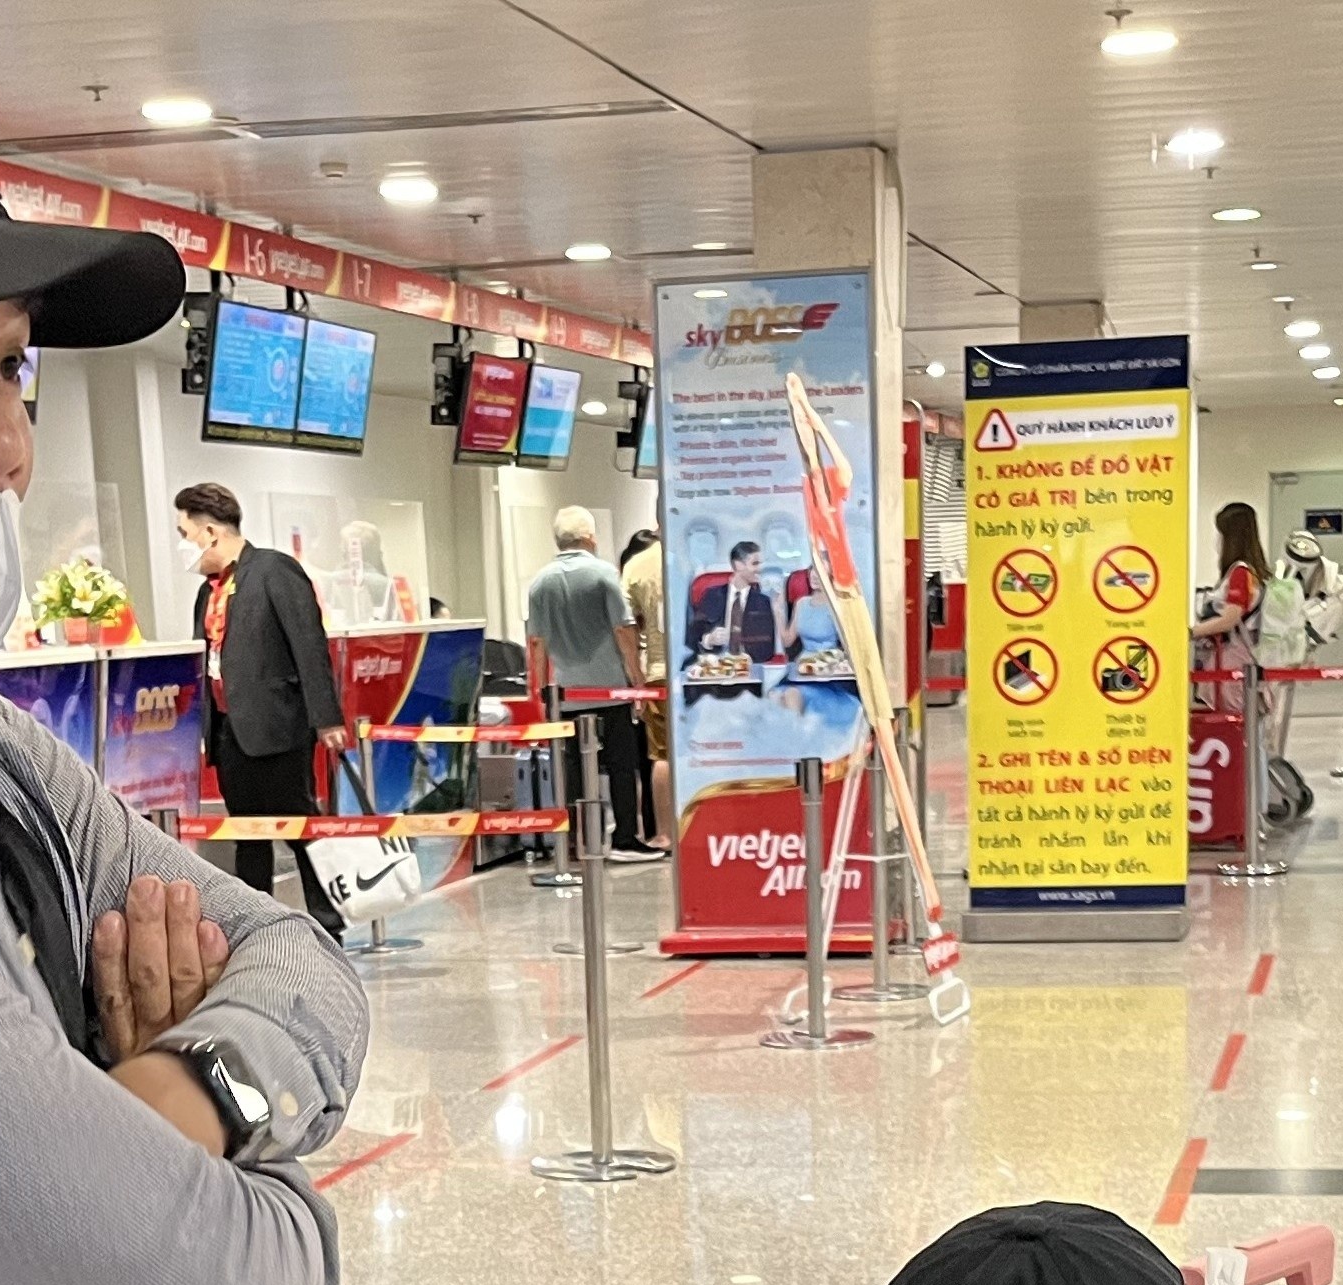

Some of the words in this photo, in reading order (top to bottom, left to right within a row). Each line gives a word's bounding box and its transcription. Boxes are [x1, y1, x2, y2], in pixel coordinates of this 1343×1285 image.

[1016, 418, 1044, 436] QUÝ
[1046, 418, 1086, 435] HÀNH
[1088, 417, 1134, 433] KHÁCH
[975, 465, 992, 481] 1.
[996, 459, 1064, 480] KHÔNG
[1008, 488, 1041, 508] GIÁ
[1048, 488, 1077, 509] TRỊ
[1085, 487, 1117, 504] bên
[1126, 488, 1173, 506] trong
[974, 521, 1018, 538] hành
[977, 753, 994, 768] 2.
[999, 751, 1031, 768] GHI
[1036, 749, 1072, 767] TÊN
[1077, 750, 1091, 767] &
[1128, 746, 1172, 768] ĐIỆN
[977, 778, 1034, 799] THOẠI
[1044, 776, 1085, 794] LIÊN
[1095, 776, 1131, 797] LẠC
[1140, 776, 1172, 792] vào
[1028, 804, 1071, 822] hành
[978, 834, 1022, 850] tránh
[1146, 830, 1172, 847] khi
[1024, 860, 1045, 878] tại
[1048, 859, 1077, 876] sân
[1081, 858, 1110, 878] bay
